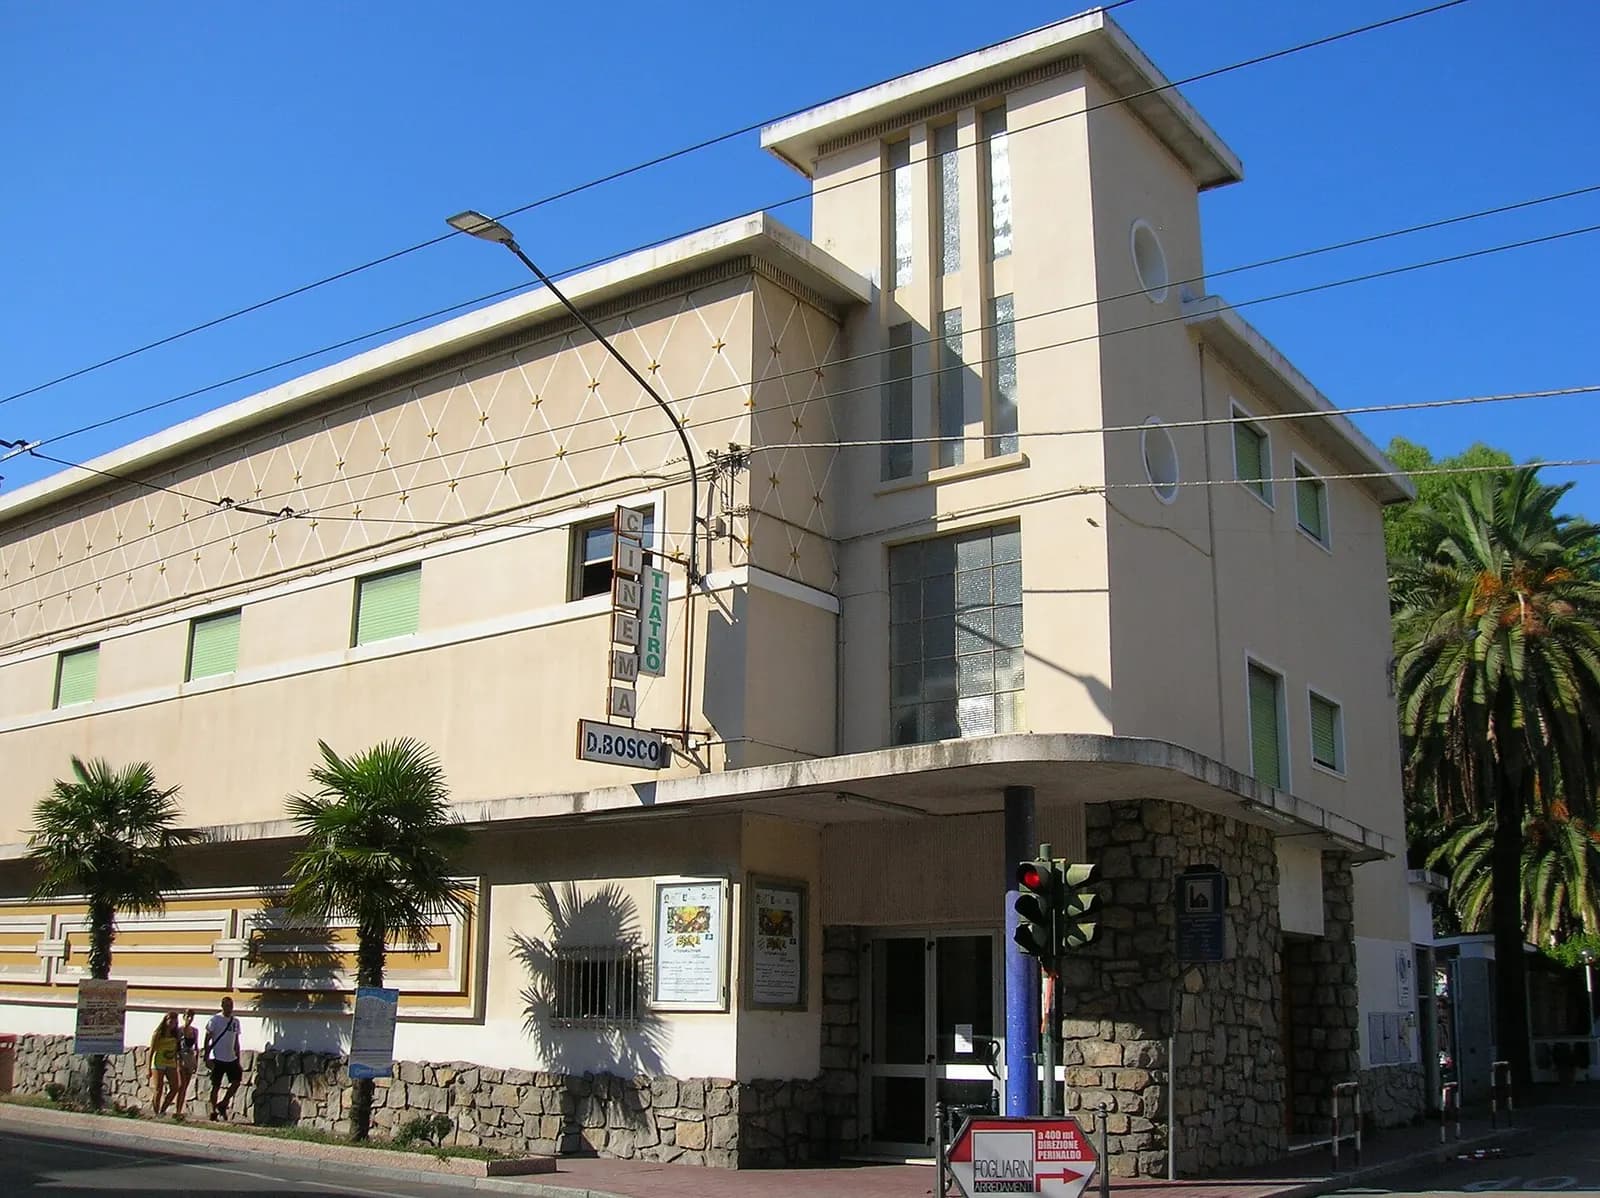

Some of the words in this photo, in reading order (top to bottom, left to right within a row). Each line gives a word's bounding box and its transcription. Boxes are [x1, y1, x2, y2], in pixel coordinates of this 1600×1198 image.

[618, 514, 639, 712] CINEMA
[645, 572, 664, 670] TEATRO
[586, 730, 661, 763] D.BOSCO
[1037, 1131, 1044, 1139] a
[1044, 1130, 1062, 1140] 400
[1062, 1131, 1074, 1140] mt
[1037, 1140, 1079, 1149] DIREZIONE
[1037, 1150, 1082, 1160] PERINALDO
